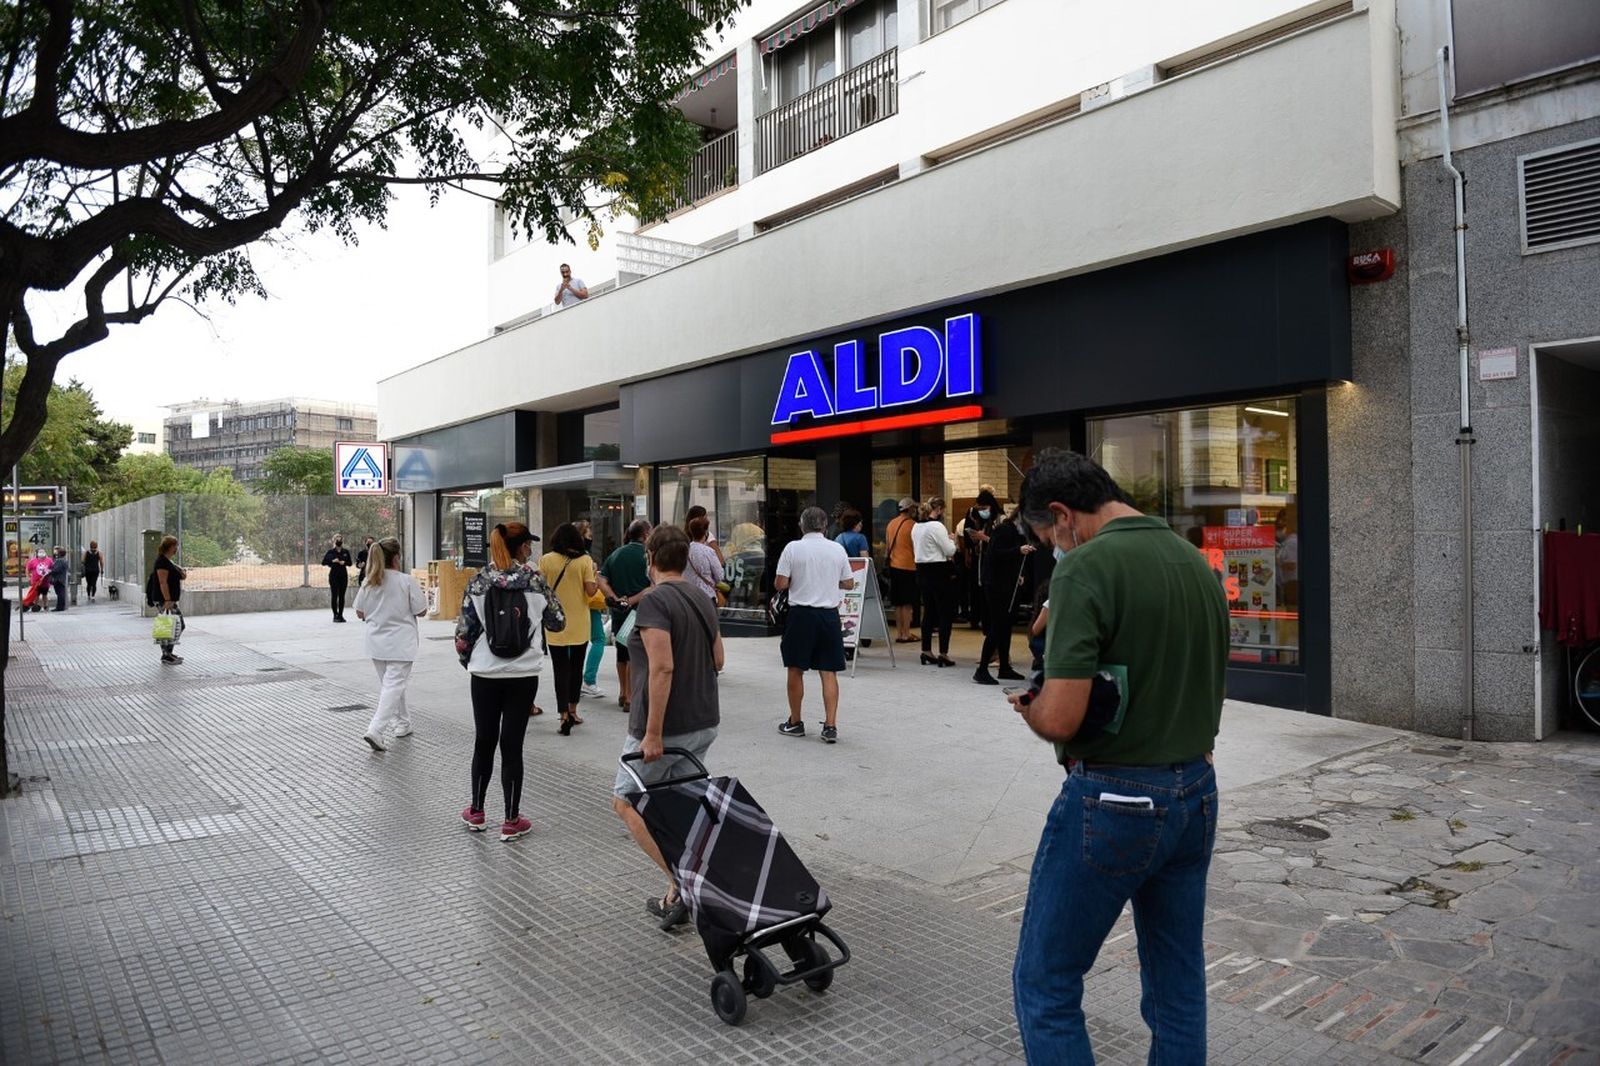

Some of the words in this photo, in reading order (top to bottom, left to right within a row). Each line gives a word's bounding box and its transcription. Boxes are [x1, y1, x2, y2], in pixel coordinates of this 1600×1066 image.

[771, 313, 982, 425] ALDI
[343, 479, 382, 489] ALDI
[1223, 529, 1253, 538] SUPER
[1223, 538, 1264, 547] OFERTAS
